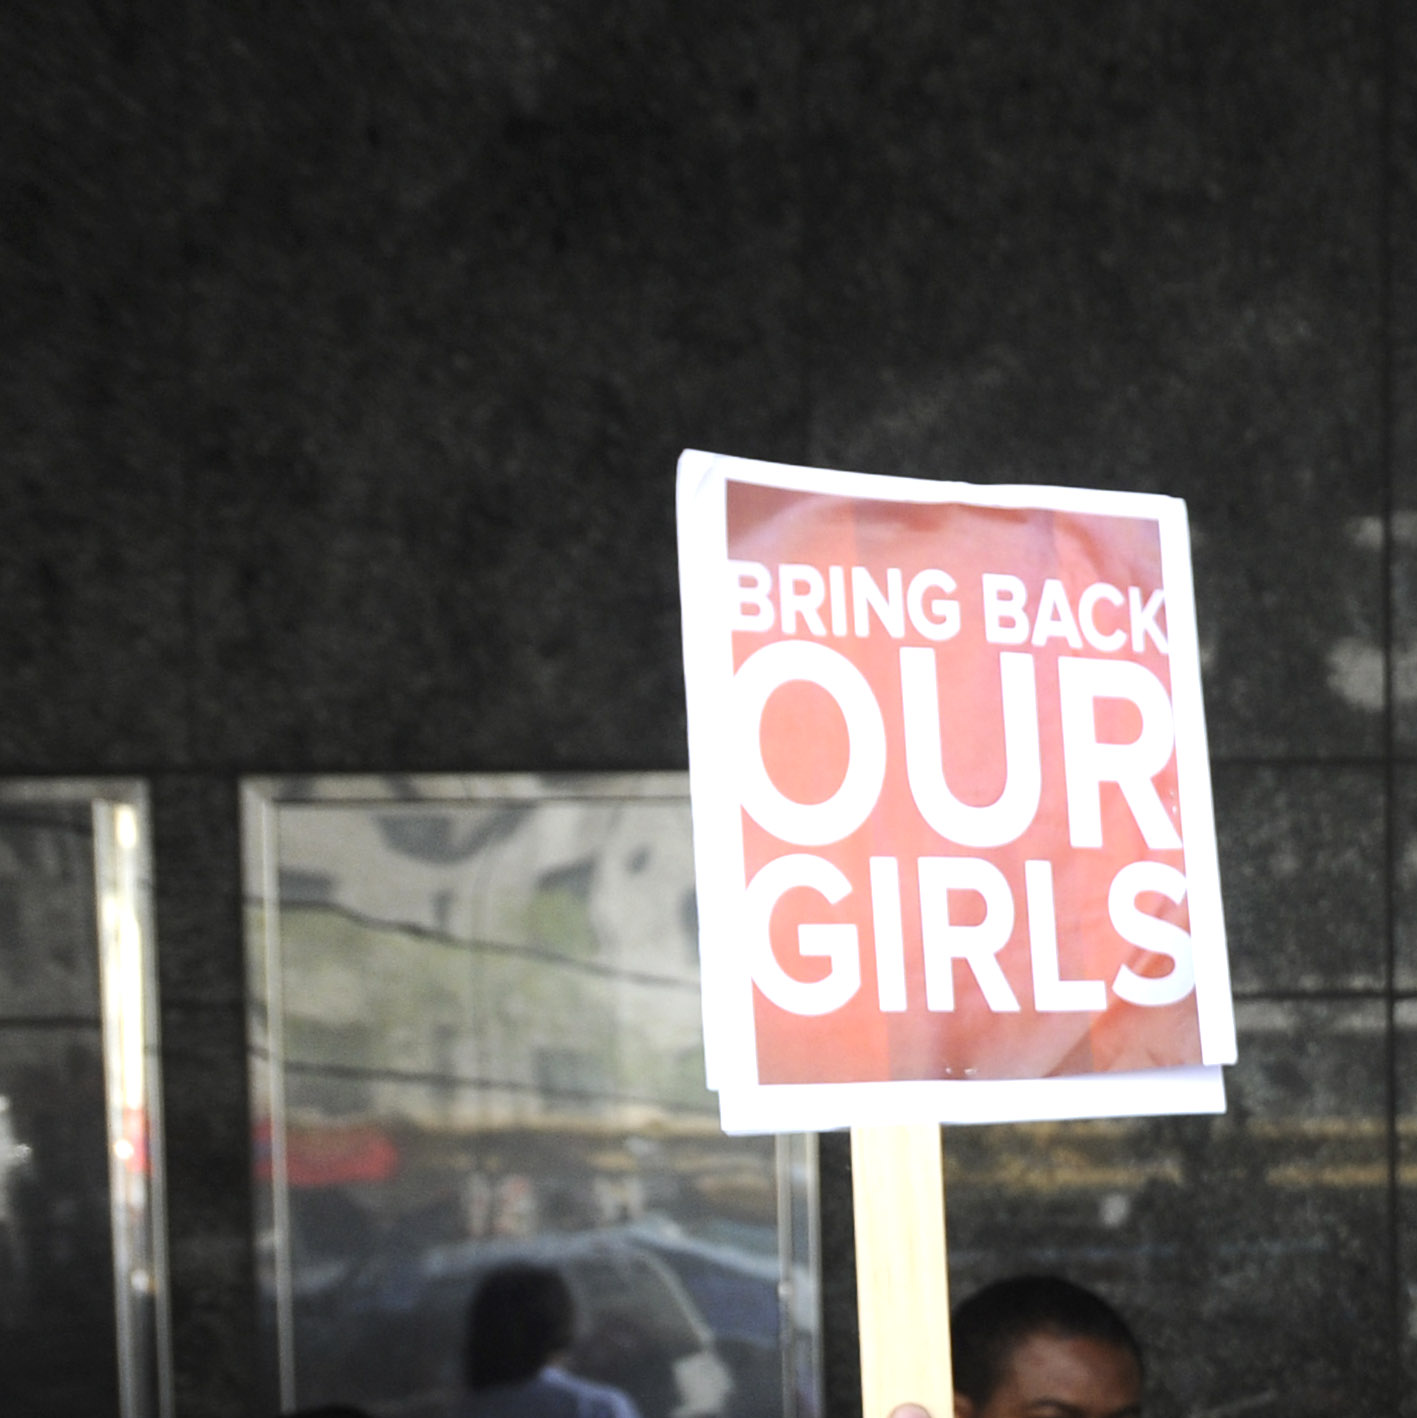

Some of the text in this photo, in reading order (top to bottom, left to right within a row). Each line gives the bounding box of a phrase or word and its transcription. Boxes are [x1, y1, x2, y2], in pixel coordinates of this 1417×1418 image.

[728, 559, 1171, 655] BRING BACK
[732, 639, 1184, 850] OUR
[744, 853, 1199, 1016] GIRLS
